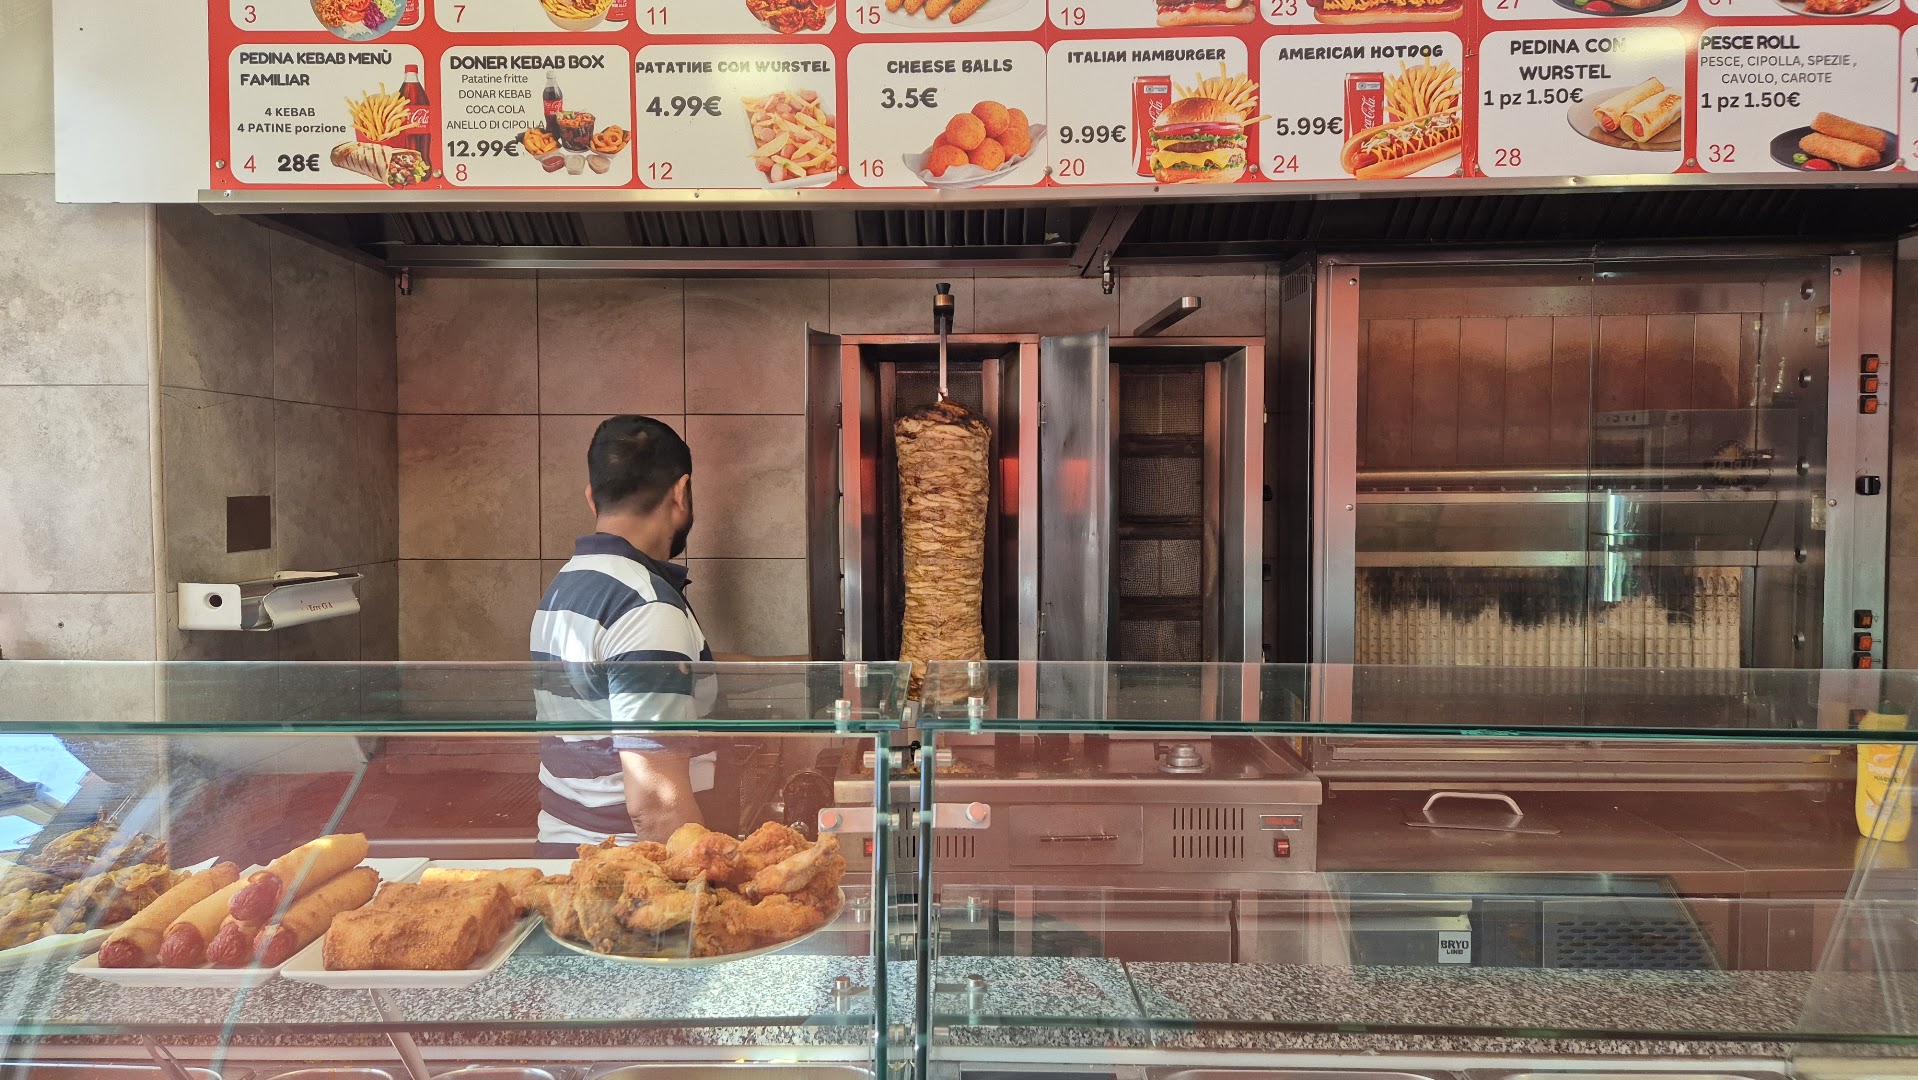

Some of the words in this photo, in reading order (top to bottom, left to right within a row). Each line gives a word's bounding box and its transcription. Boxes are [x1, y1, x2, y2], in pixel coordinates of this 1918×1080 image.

[245, 5, 256, 23] 3
[454, 5, 465, 23] 7
[647, 7, 666, 25] 11
[857, 6, 880, 24] 15
[1271, 0, 1297, 16] 23
[1061, 8, 1085, 26] 19
[1511, 39, 1580, 55] PEDINA
[1587, 38, 1626, 53] CON
[1701, 36, 1753, 49] PESCE
[1757, 35, 1800, 49] ROLL
[240, 52, 294, 64] PEDINA
[297, 52, 346, 64] KEBAB
[349, 49, 392, 64] MENÙ
[1068, 51, 1126, 63] ITALIAN
[1132, 49, 1225, 62] HAMBURGER
[1279, 46, 1364, 60] AMERICAN
[1371, 45, 1443, 58] HOTDOG
[450, 56, 507, 69] DONER
[511, 56, 565, 69] KEBAB
[569, 55, 604, 69] BOX
[635, 62, 712, 74] PATATINE
[718, 61, 749, 72] CON
[756, 61, 830, 72] WURSTEL
[887, 60, 956, 73] CHEESE
[962, 59, 1012, 73] BALLS
[1701, 56, 1743, 68] PESCE,
[1748, 56, 1804, 67] CIPOLLA,
[241, 74, 310, 86] FAMILIAR
[462, 74, 502, 83] Patatine
[504, 74, 528, 83] fritte
[1519, 64, 1611, 80] WURSTEL
[1722, 74, 1777, 85] CAVOLO,
[1781, 73, 1832, 83] CAROTE
[459, 90, 496, 98] DONAR
[499, 90, 531, 98] KEBAB
[881, 88, 938, 108] 3.5€
[1484, 90, 1494, 105] 1
[1500, 93, 1521, 109] pz
[1527, 88, 1583, 104] 1.50€
[1702, 93, 1711, 108] 1
[1718, 97, 1739, 112] pz
[1745, 92, 1800, 107] 1.50€
[265, 108, 272, 116] 4
[276, 108, 315, 116] KEBAB
[466, 105, 494, 113] COCA
[497, 105, 525, 113] COLA
[646, 96, 721, 116] 4.99€
[238, 124, 245, 132] 4
[248, 123, 292, 132] PATINE
[295, 123, 346, 135] porzione
[447, 121, 487, 129] ANELLO
[490, 121, 499, 129] DI
[502, 121, 545, 131] CIPOLLA
[1060, 125, 1126, 143] 9.99€
[1277, 117, 1343, 136] 5.99€
[448, 139, 519, 157] 12.99€
[1709, 144, 1735, 162] 32
[244, 155, 256, 172] 4
[278, 154, 319, 172] 28€
[1273, 155, 1298, 173] 24
[1495, 148, 1521, 166] 28
[456, 164, 467, 181] 8
[649, 162, 672, 179] 12
[860, 160, 883, 177] 16
[1059, 159, 1084, 176] 20
